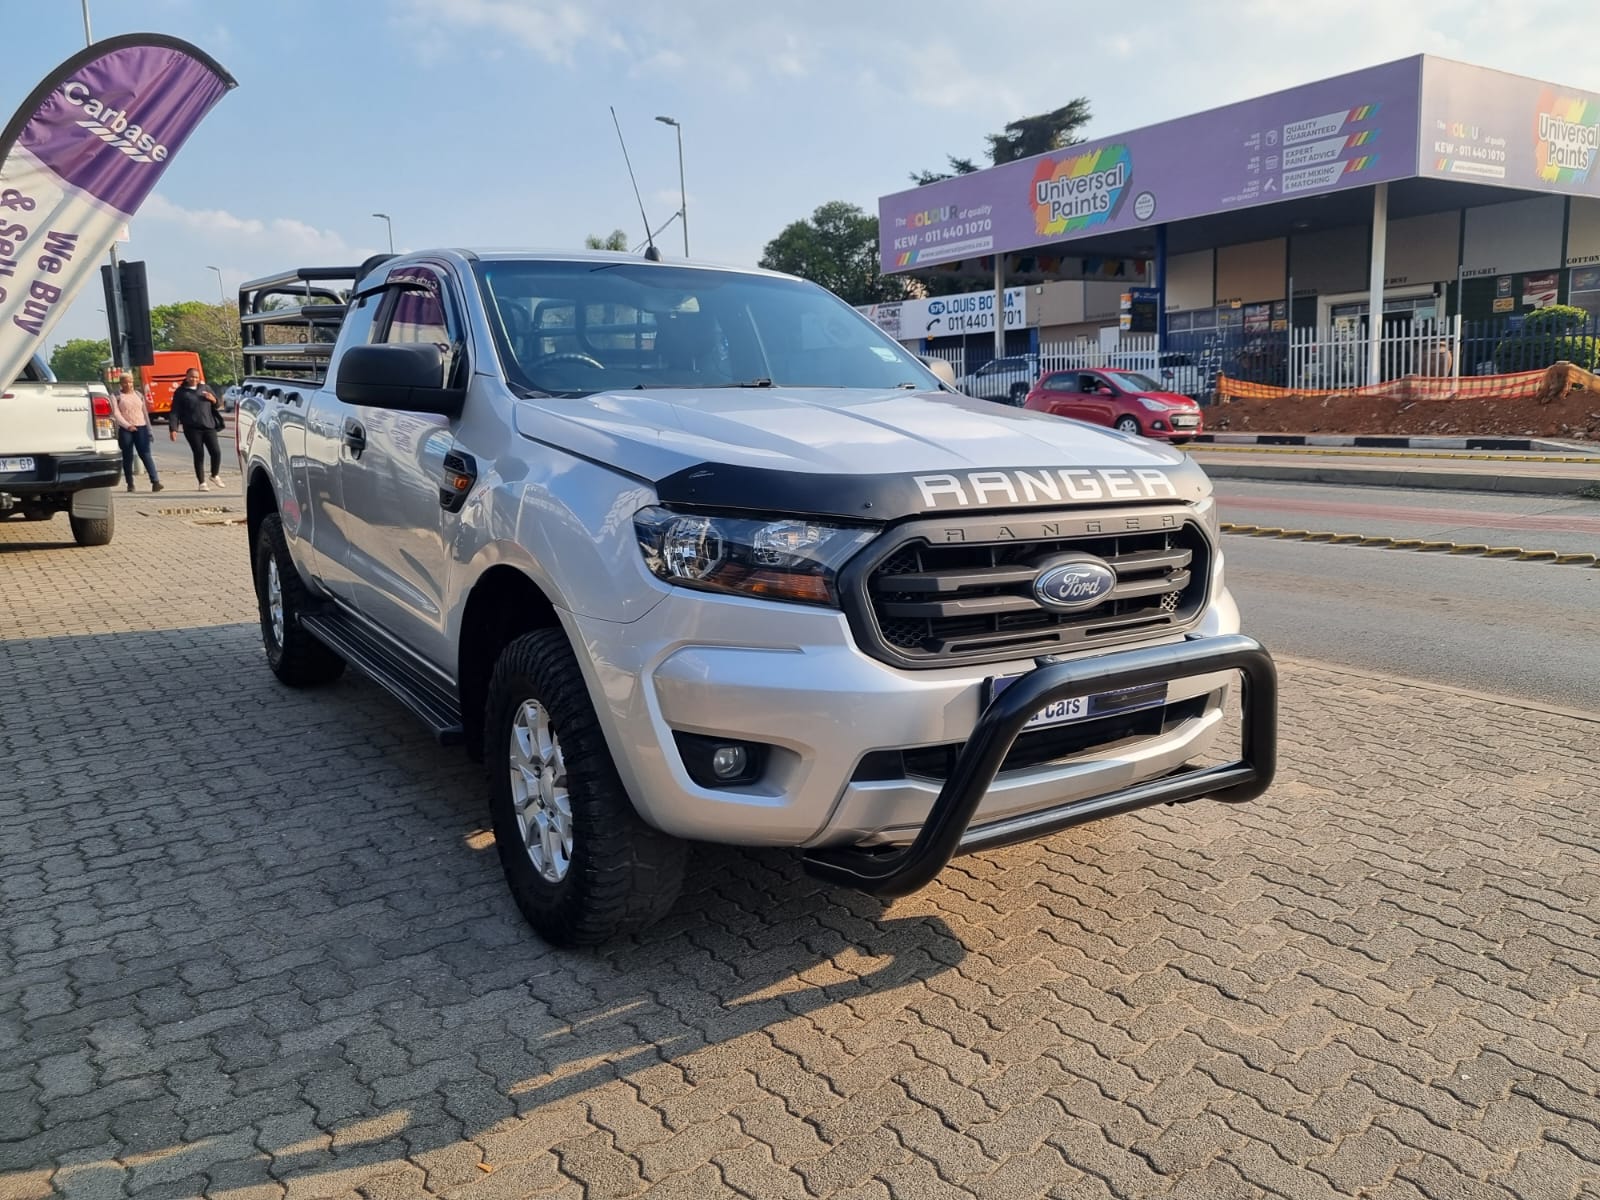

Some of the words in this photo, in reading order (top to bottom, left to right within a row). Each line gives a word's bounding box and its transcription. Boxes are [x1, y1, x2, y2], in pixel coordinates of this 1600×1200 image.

[64, 81, 169, 162] Carbase
[1286, 121, 1317, 135] QUALITY
[1286, 125, 1337, 142] GUARANTEED
[1539, 112, 1599, 148] Universal
[1285, 146, 1314, 158] EXPERT
[1285, 155, 1307, 166] PAINT
[1308, 150, 1337, 161] ADVICE
[1434, 141, 1454, 154] KEW
[1459, 145, 1471, 157] 011
[1472, 147, 1487, 159] 440
[1488, 149, 1505, 161] 1070
[1549, 141, 1589, 168] Paints
[1038, 163, 1123, 203] Universal
[1285, 172, 1306, 183] PAINT
[1307, 166, 1335, 178] MIXING
[1290, 176, 1330, 189] MATCHING
[1, 188, 36, 213] &
[1051, 191, 1109, 220] Paints
[895, 218, 906, 227] The
[907, 205, 958, 229] COLOUR
[959, 209, 968, 219] of
[968, 205, 992, 218] quality
[894, 234, 918, 250] KEW
[925, 229, 941, 243] 011
[943, 225, 963, 239] 440
[965, 219, 992, 235] 1070
[37, 230, 79, 274] We
[13, 279, 62, 337] Buy
[946, 299, 976, 315] LOUIS
[979, 292, 1015, 311] BOA
[948, 315, 965, 331] 011
[966, 312, 987, 328] 440
[20, 458, 33, 470] GP
[912, 469, 1179, 508] RANGER
[943, 515, 1178, 542] RANGER
[1058, 571, 1102, 599] Ford
[1045, 698, 1081, 719] Cars
